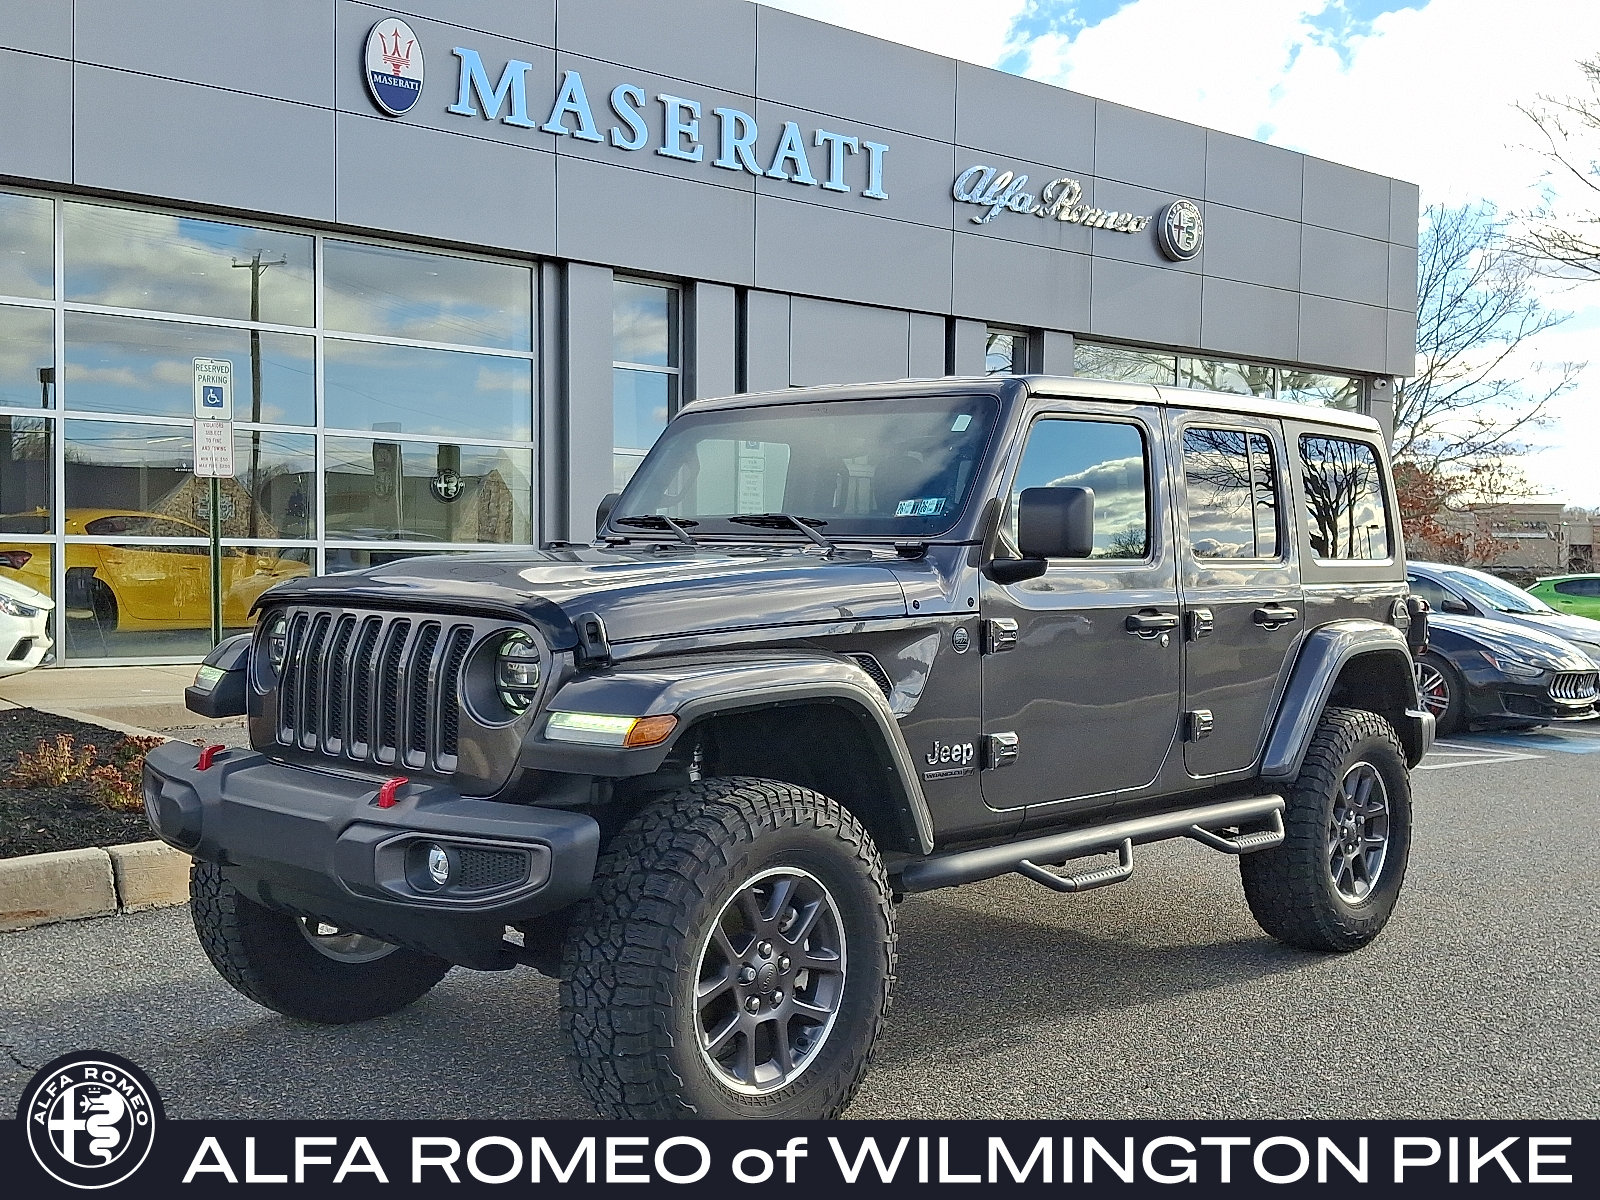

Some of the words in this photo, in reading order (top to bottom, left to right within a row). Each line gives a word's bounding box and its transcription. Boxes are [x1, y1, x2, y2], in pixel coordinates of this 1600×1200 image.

[373, 74, 419, 91] MASERATI
[447, 46, 890, 200] MASERATI
[953, 165, 1038, 224] Alfa
[1036, 177, 1152, 234] Romeo
[196, 363, 230, 374] RESERVED
[198, 374, 228, 384] PARKING
[925, 741, 974, 765] Jeep
